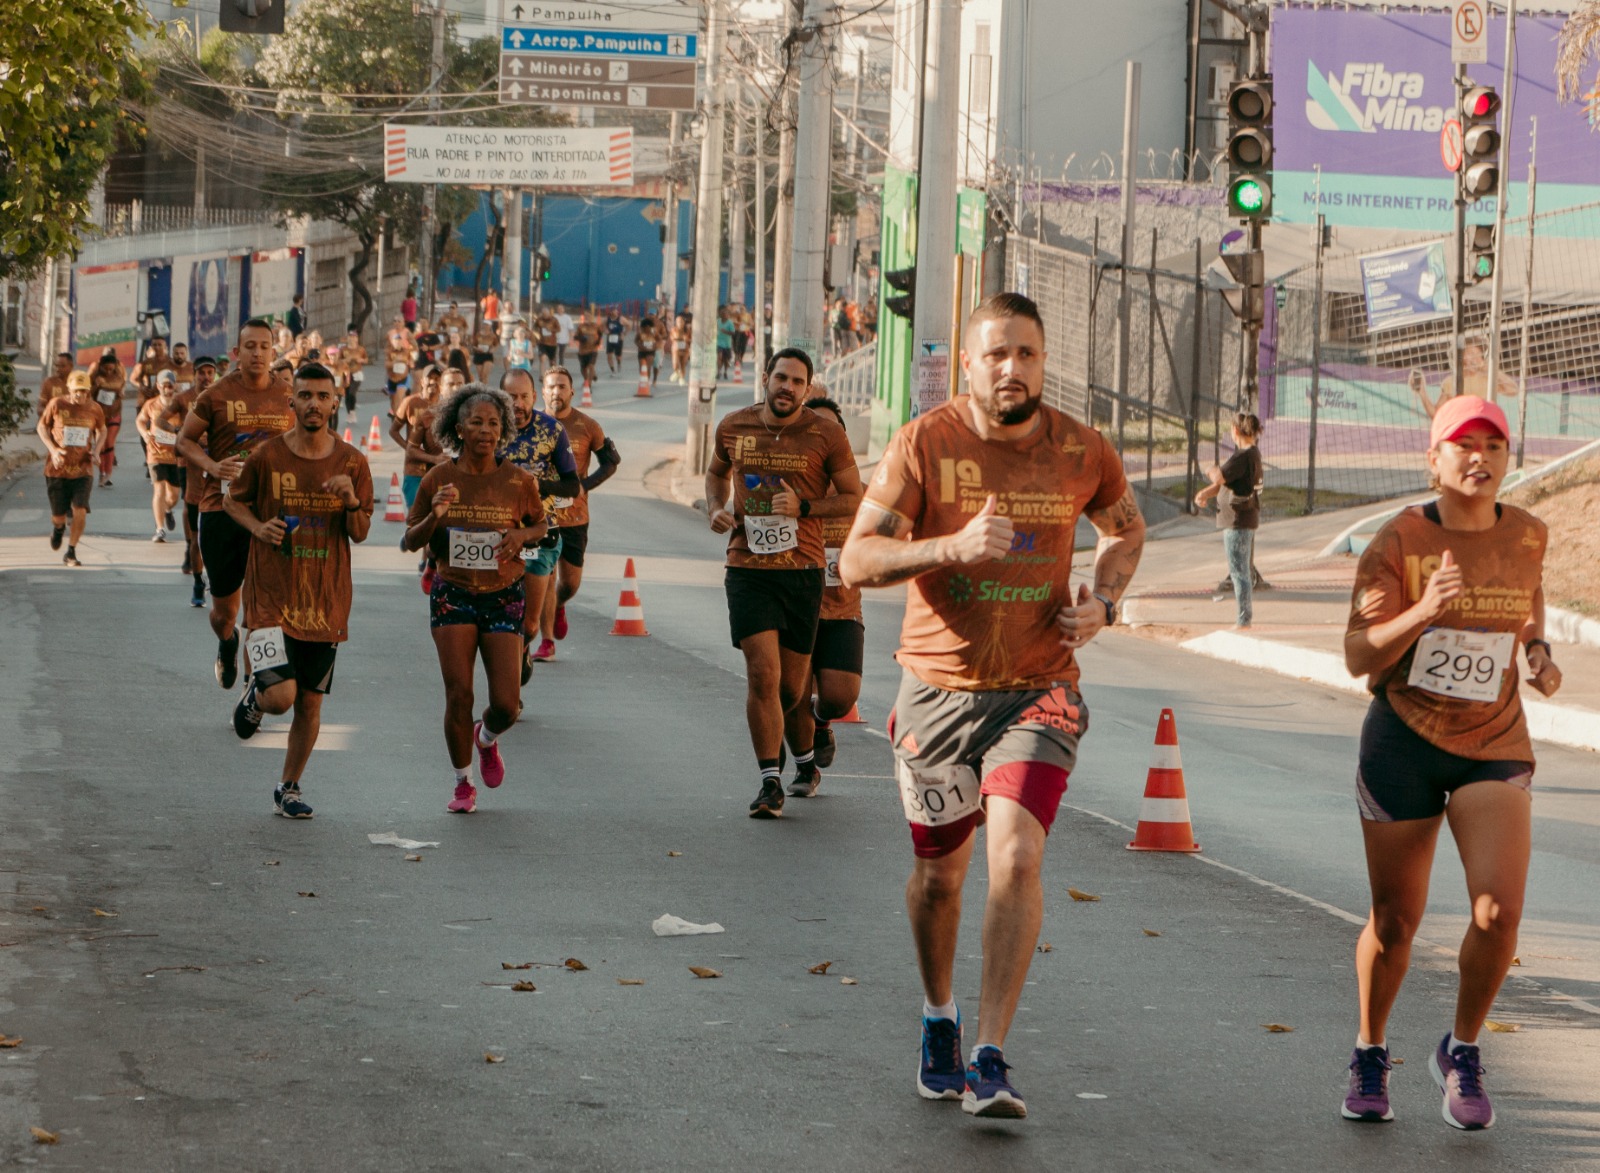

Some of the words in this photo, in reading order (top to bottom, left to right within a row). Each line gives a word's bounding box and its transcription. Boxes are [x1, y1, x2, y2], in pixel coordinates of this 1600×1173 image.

[532, 7, 612, 21] Pampulha
[531, 33, 582, 50] Aerop.
[584, 35, 662, 52] Pampulha
[529, 61, 602, 77] Mineirão
[1341, 63, 1424, 99] Fibra
[528, 85, 622, 102] Expominas
[445, 133, 497, 147] ATENÇÃO
[504, 135, 567, 146] MOTORISTA
[407, 148, 429, 161] RUA
[435, 149, 470, 161] PADRE
[487, 151, 524, 163] PINTO
[532, 151, 606, 163] INTERDITADA
[436, 167, 450, 178] NO
[454, 168, 470, 178] DIA
[510, 169, 528, 179] DAS
[1303, 191, 1343, 206] MAIS
[1346, 193, 1424, 211] INTERNET
[1365, 261, 1409, 278] Contratando
[743, 457, 769, 466] SANTO
[771, 458, 808, 468] ANTÔNIO
[283, 498, 310, 507] SANTO
[1008, 491, 1063, 501] Caminhada
[447, 510, 474, 518] SANTO
[476, 510, 513, 520] ANTÔNIO
[960, 500, 1008, 515] SANO
[1012, 501, 1074, 517] ANTÔNIO
[752, 525, 792, 546] 265
[454, 544, 494, 562] 290
[977, 579, 1053, 602] Sicredi
[252, 641, 277, 663] 36
[1425, 650, 1495, 684] 299
[907, 784, 964, 813] 301
